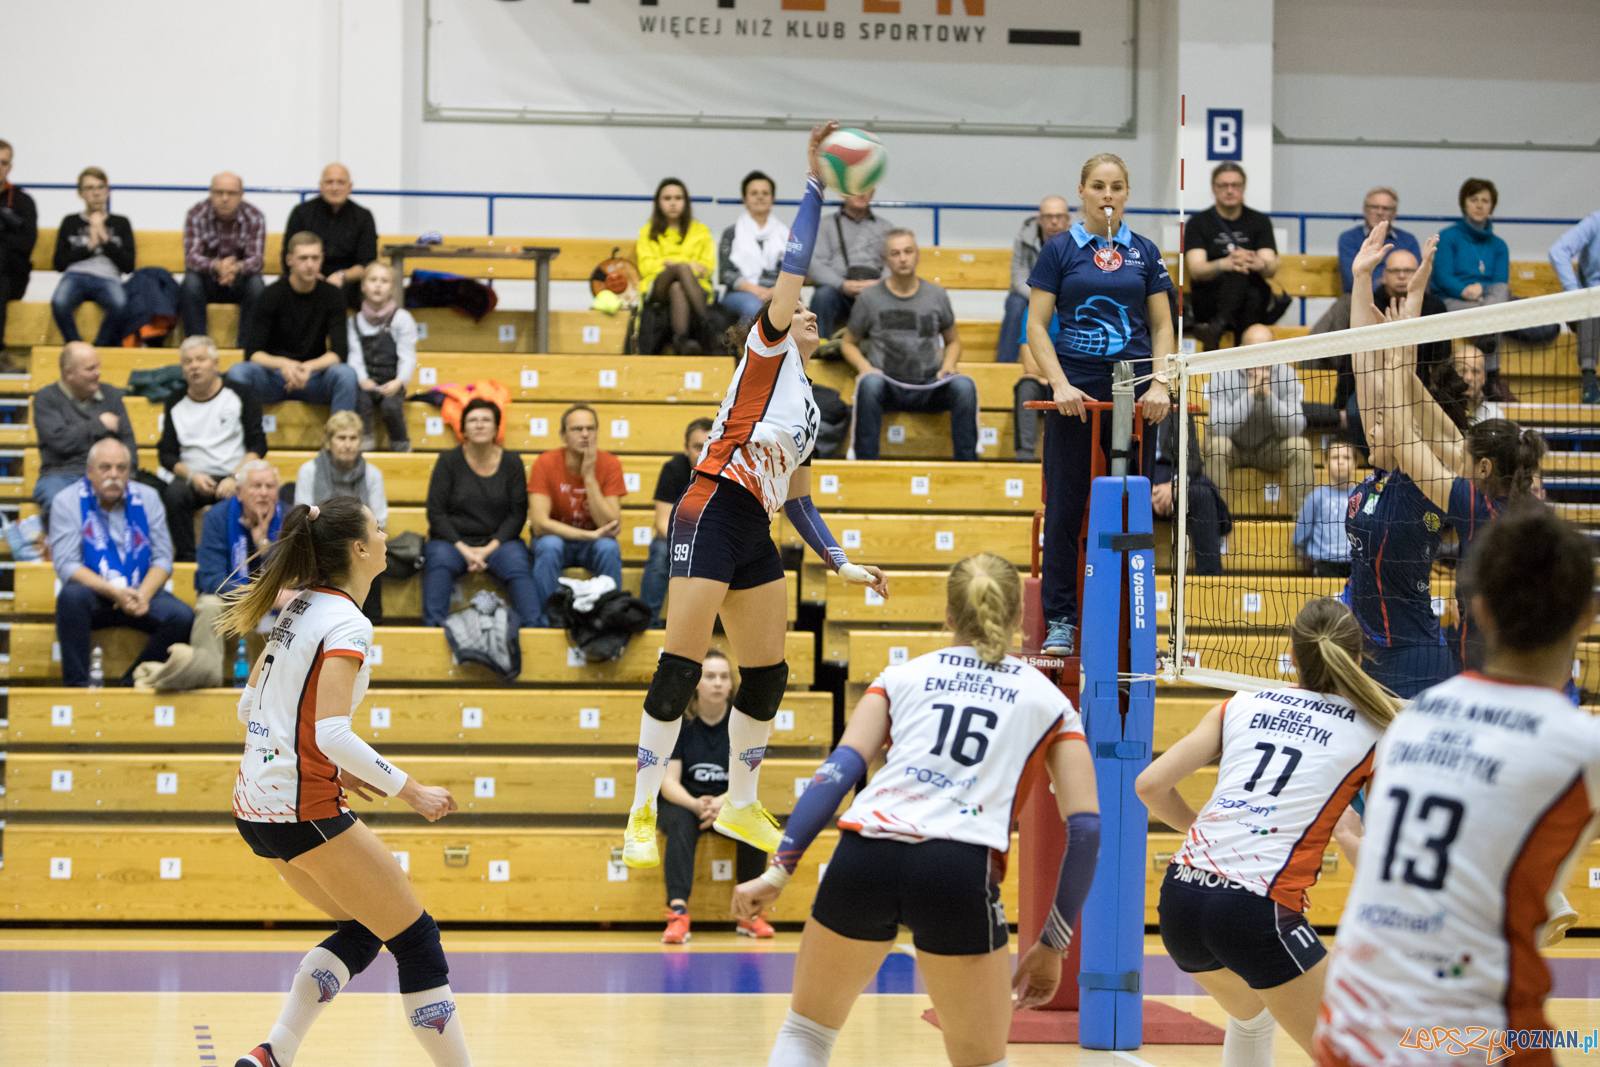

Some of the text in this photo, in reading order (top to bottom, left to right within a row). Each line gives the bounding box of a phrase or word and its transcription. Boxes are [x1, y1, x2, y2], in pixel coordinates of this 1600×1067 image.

[639, 16, 722, 38] WIĘCEJ
[786, 20, 846, 39] KLUB
[859, 22, 986, 43] SPORTOWY
[1213, 116, 1237, 154] B
[674, 544, 689, 561] 99
[1133, 572, 1145, 629] Senoh
[938, 653, 1022, 676] TOBIASZ
[955, 671, 994, 684] ENEA
[1029, 658, 1064, 668] Senoh
[261, 654, 275, 710] 7
[924, 677, 1019, 704] ENERGETYK
[1254, 691, 1357, 722] MUSZYŃSKA
[1278, 708, 1312, 725] ENEA
[929, 703, 998, 767] 16
[1249, 713, 1333, 747] ENERGETYK
[1243, 741, 1303, 798] 11
[1381, 787, 1465, 891] 13
[1290, 925, 1315, 949] 11
